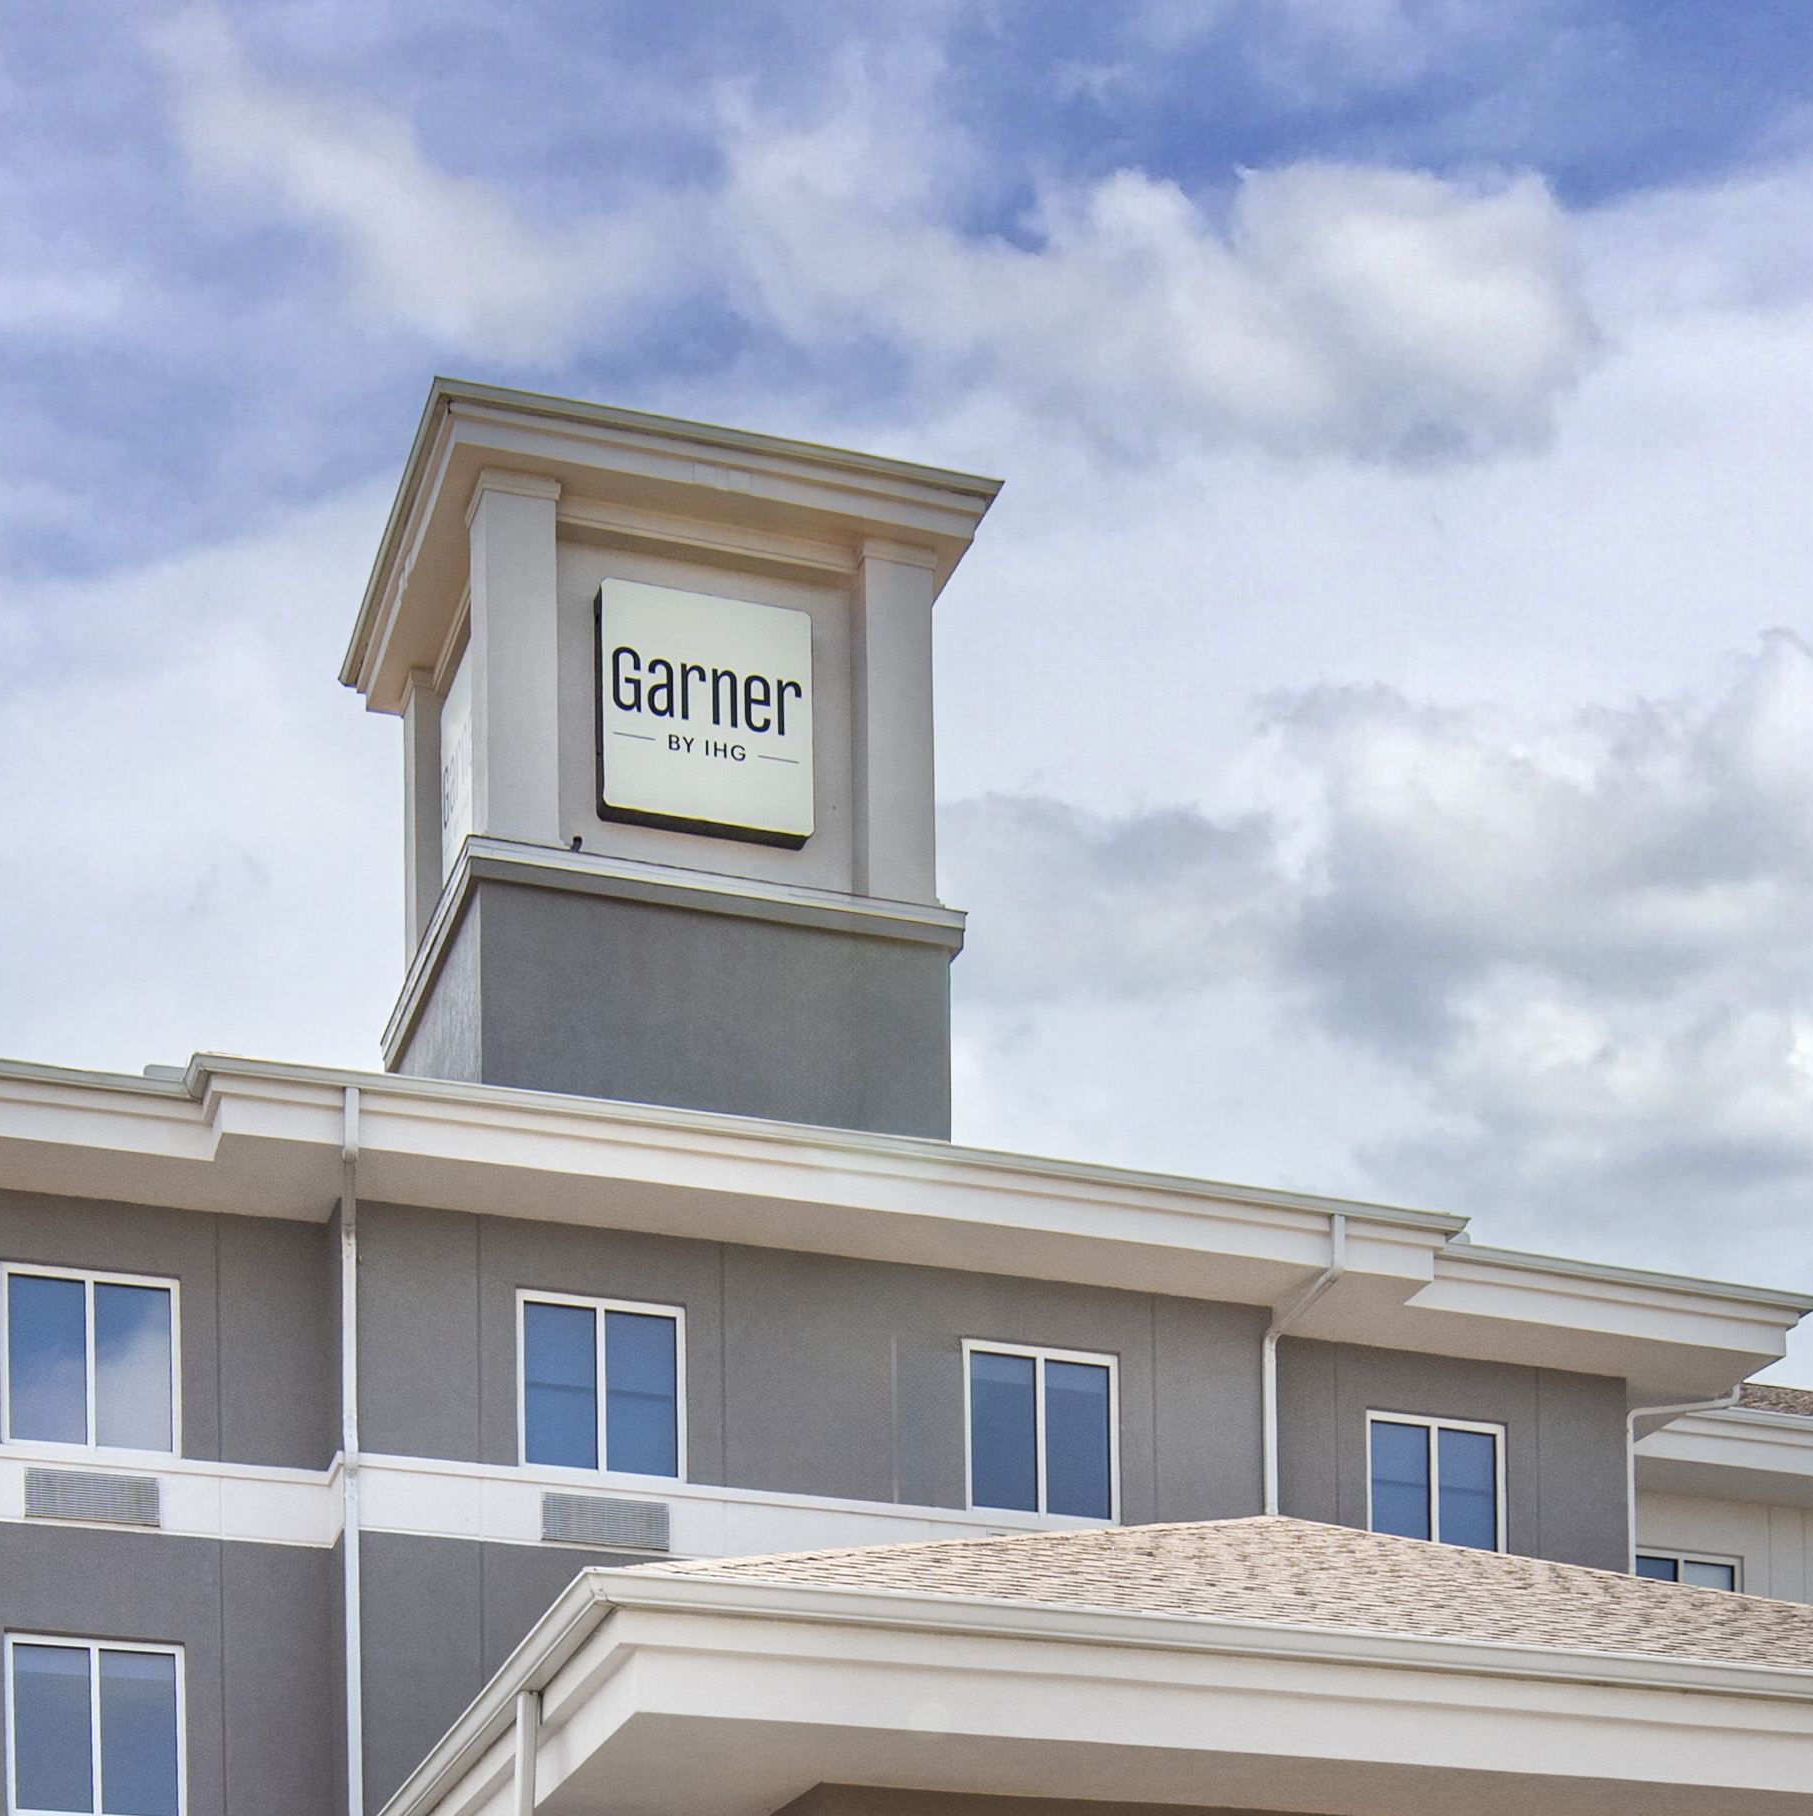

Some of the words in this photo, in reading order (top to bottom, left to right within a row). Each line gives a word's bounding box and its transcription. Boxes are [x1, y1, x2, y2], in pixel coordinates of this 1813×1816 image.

[612, 646, 803, 736] Garner
[442, 709, 473, 830] Garn
[668, 734, 695, 754] BY
[705, 739, 746, 762] IHG
